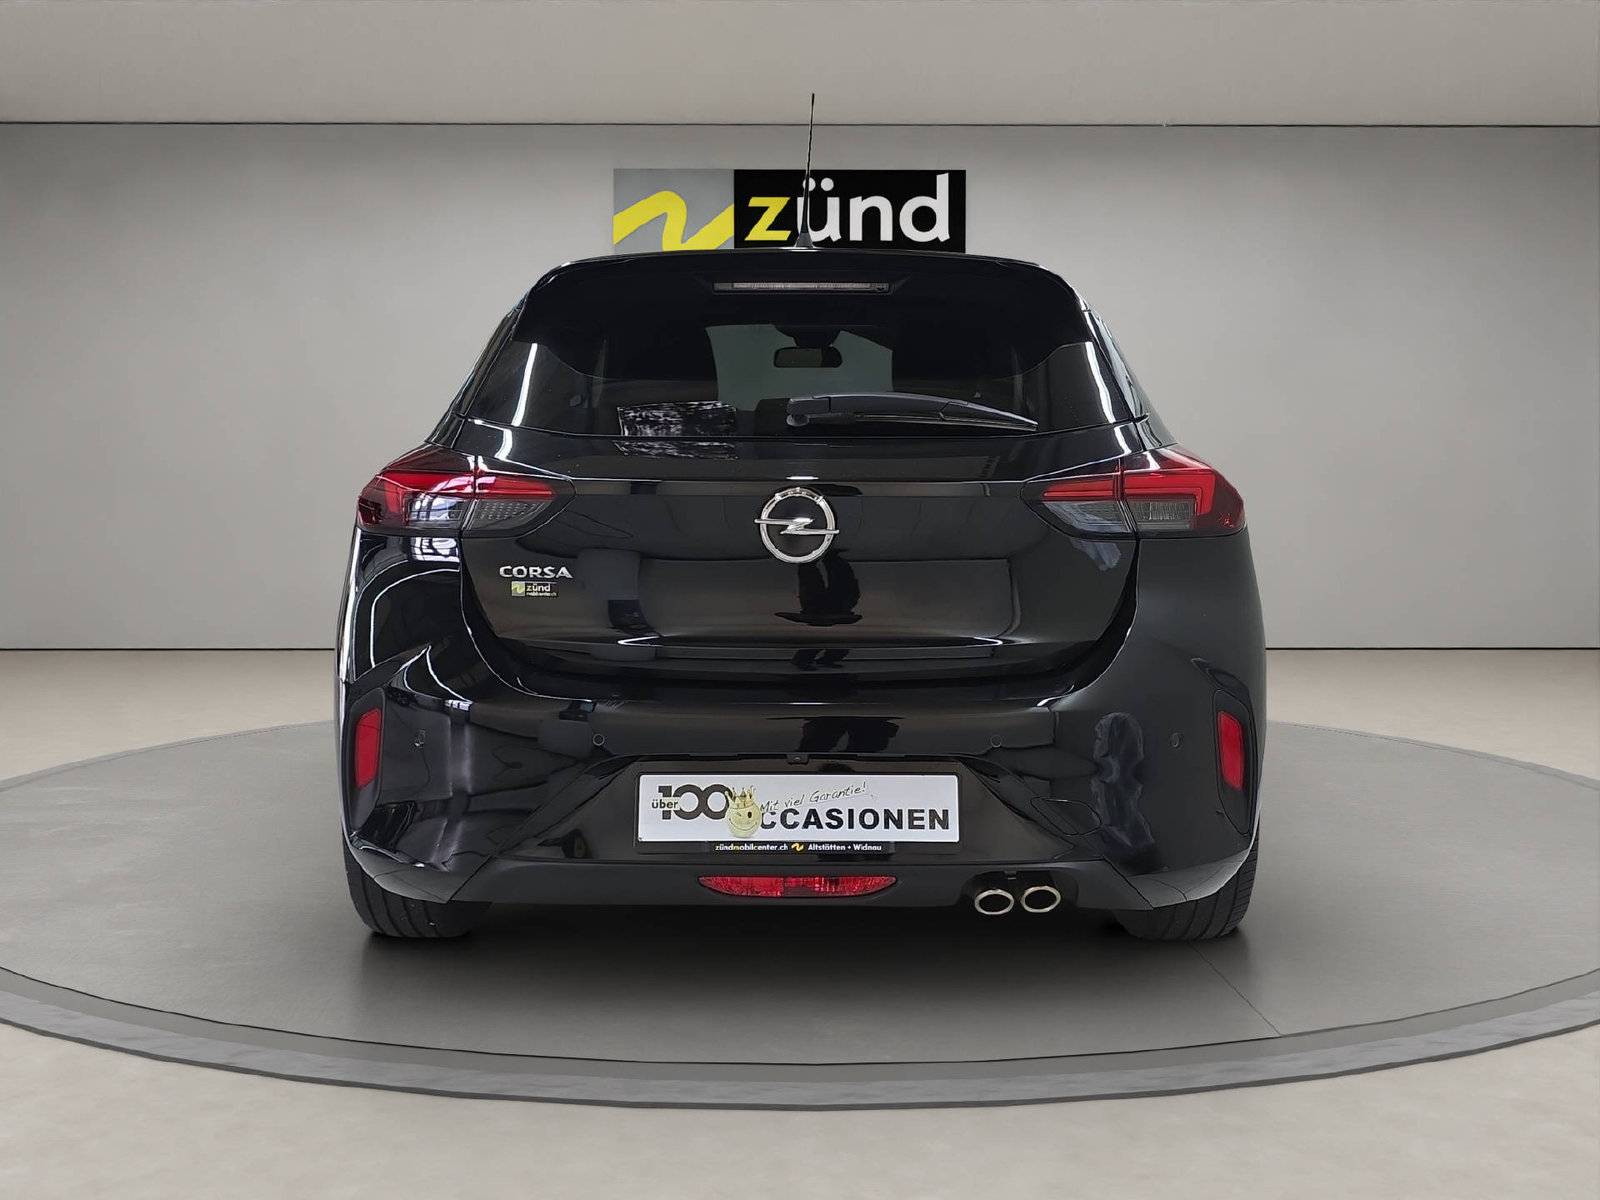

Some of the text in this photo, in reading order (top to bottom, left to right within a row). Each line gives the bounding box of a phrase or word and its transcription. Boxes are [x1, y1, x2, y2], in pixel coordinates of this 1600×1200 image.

[744, 172, 950, 243] zünd
[499, 565, 573, 579] CORSA
[526, 582, 551, 592] zünd
[651, 799, 679, 809] über
[658, 783, 734, 821] 100
[760, 781, 867, 813] Mit viel Garantie!
[760, 808, 950, 830] CCASIONEN
[715, 842, 789, 851] zündmobilcenter.ch
[807, 842, 846, 851] Altstätten
[853, 843, 882, 851] Widnau
